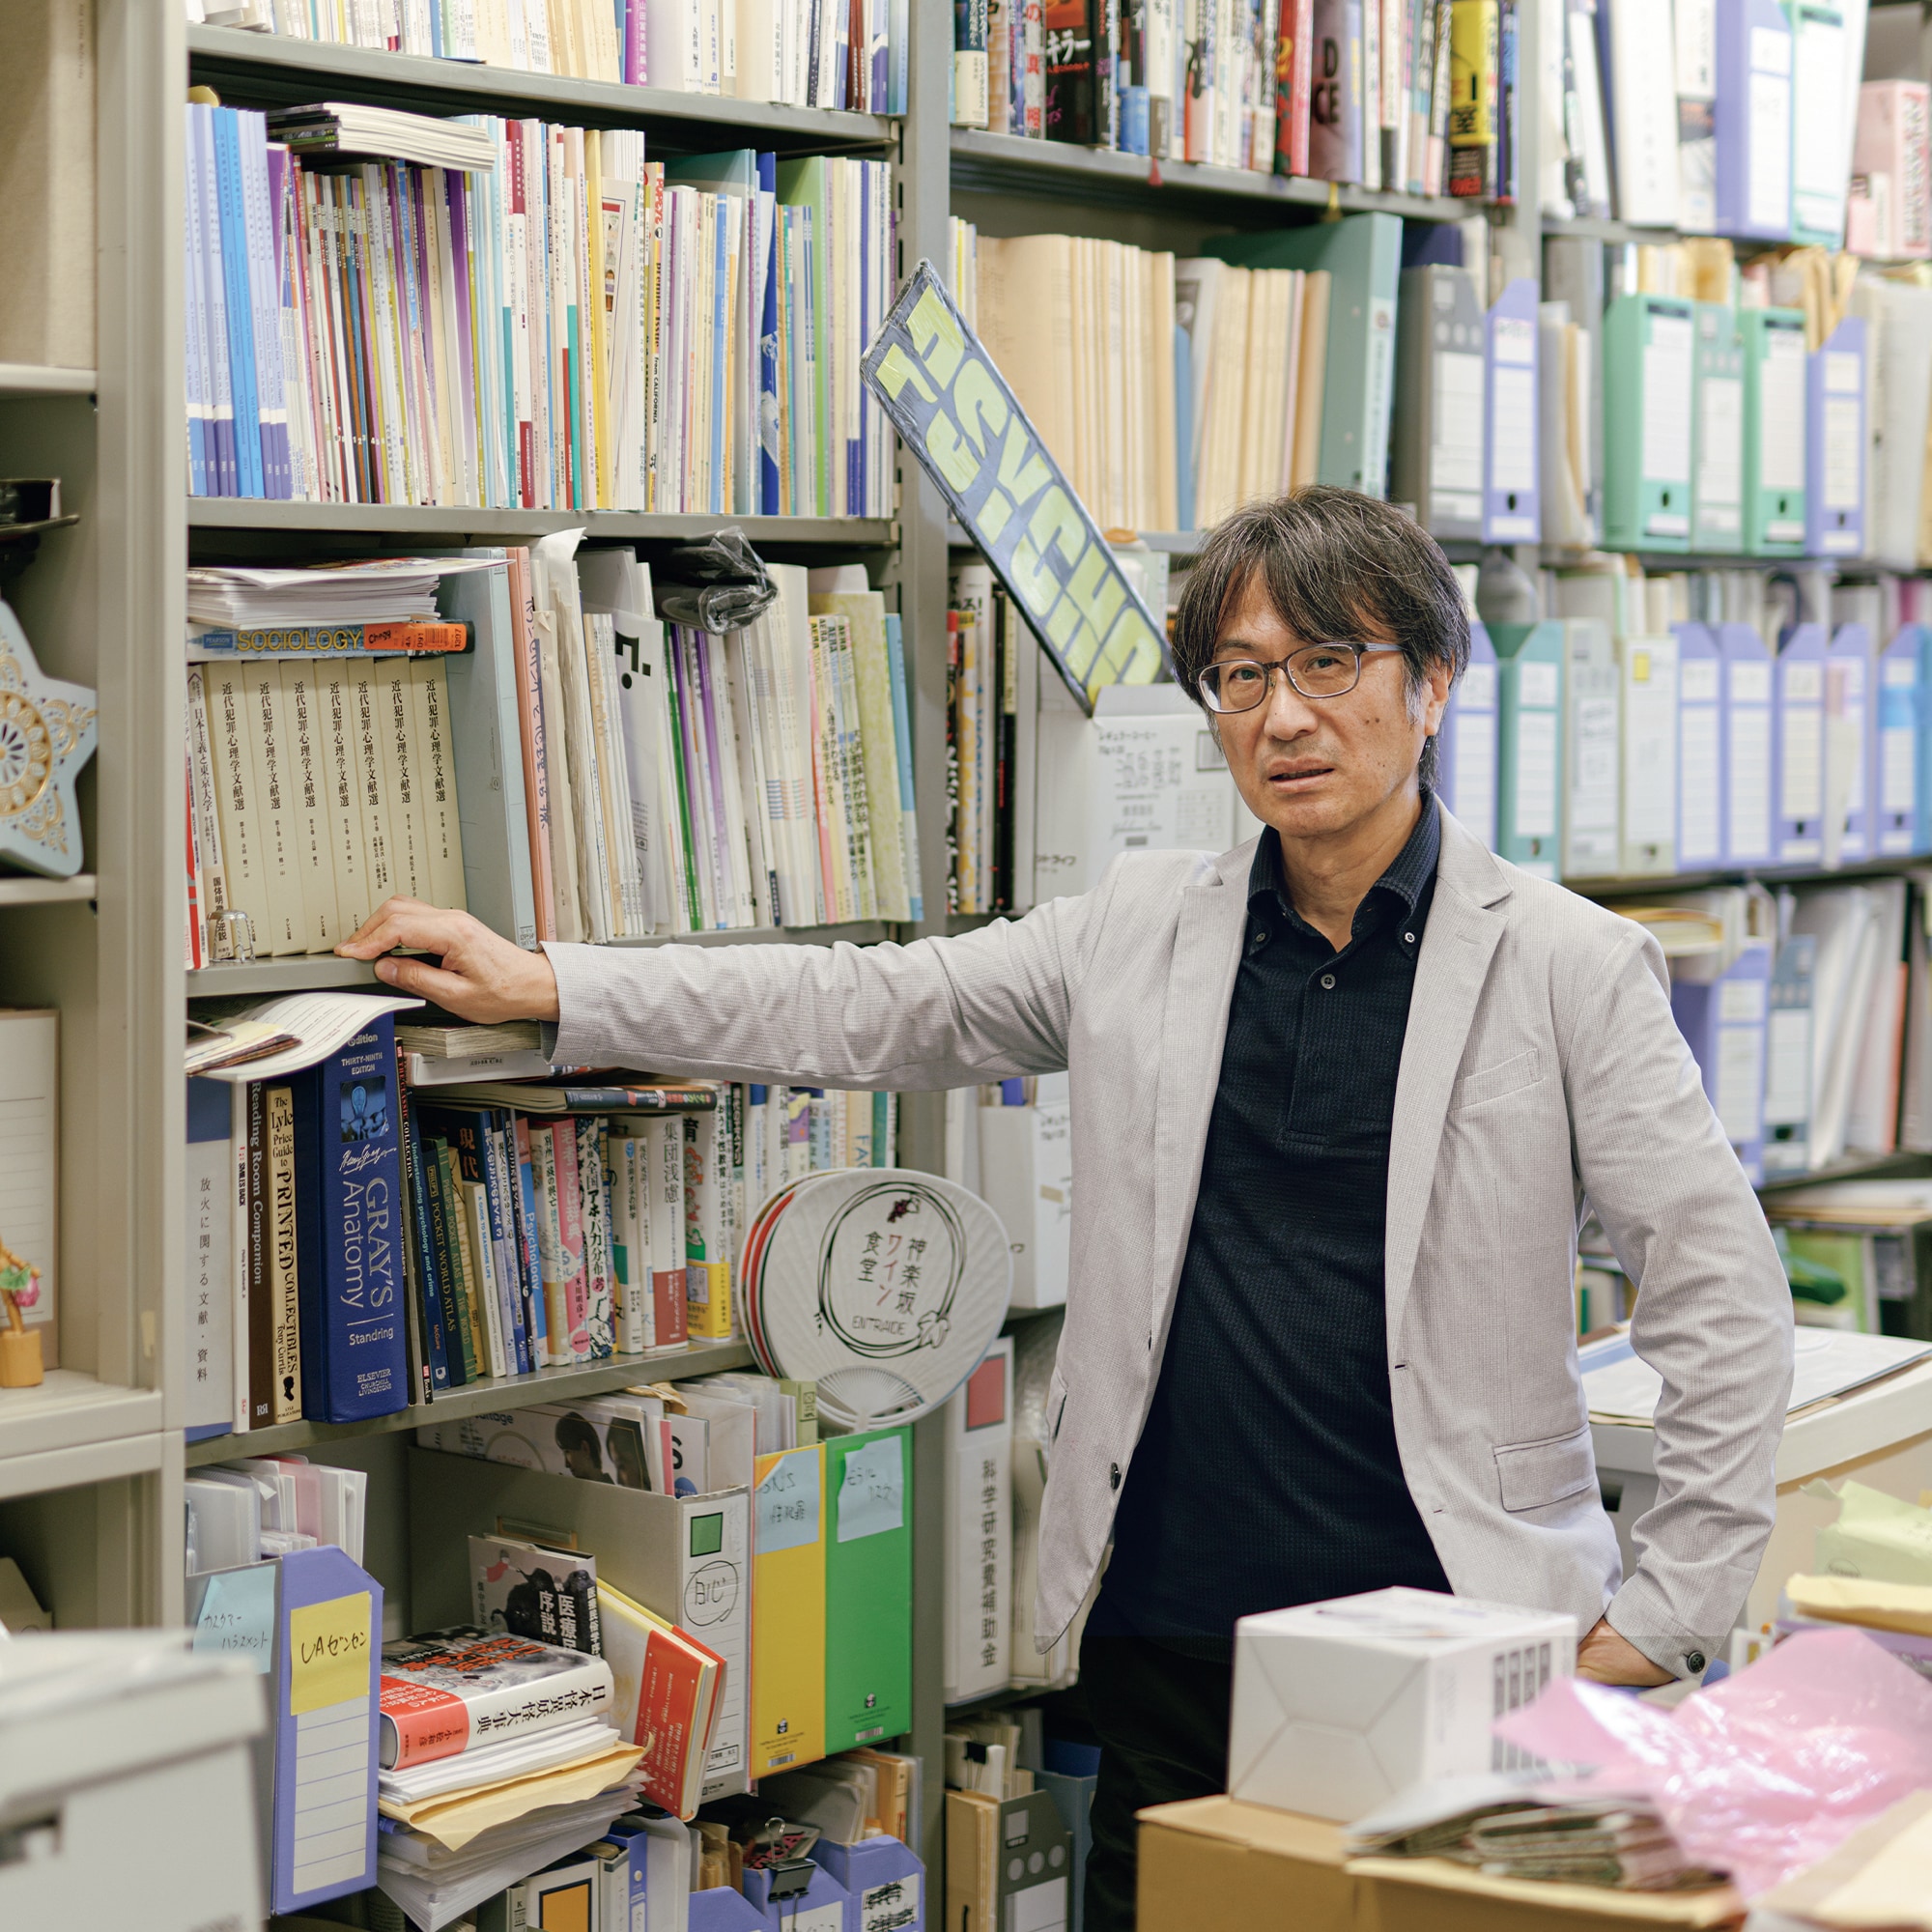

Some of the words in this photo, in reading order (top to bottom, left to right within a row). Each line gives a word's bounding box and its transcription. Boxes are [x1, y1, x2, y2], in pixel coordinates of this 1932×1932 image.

[1047, 29, 1092, 66] キラー
[655, 179, 664, 225] POPEYE
[206, 636, 230, 644] PEARSON
[238, 630, 363, 652] SOCIOLOGY
[368, 630, 391, 644] Chegg
[194, 707, 213, 812] 日本主義と東京大学
[222, 682, 245, 811] 近代犯罪心理学文献選
[259, 681, 281, 810] 近代犯罪心理学文献選
[294, 681, 316, 809] 近代犯罪心理学文献選
[329, 680, 350, 808] 近代犯罪心理学文献選
[357, 680, 379, 807] 近代犯罪心理学文献選
[391, 679, 412, 804] 近代犯罪心理学文献選
[426, 678, 446, 803] 近代犯罪心理学文献選
[341, 1051, 383, 1066] THIRTY-NINTH
[351, 1065, 375, 1075] EDITION
[249, 1081, 262, 1148] Reading
[271, 1110, 294, 1132] Lyle
[274, 1096, 288, 1107] The
[272, 1145, 294, 1158] Guide
[273, 1134, 293, 1146] Price
[404, 1122, 413, 1179] COLLECTION
[459, 1127, 480, 1179] 現代
[683, 1116, 699, 1143] 育
[251, 1151, 263, 1197] Room
[280, 1158, 288, 1167] to
[663, 1122, 679, 1204] 集団浅慮
[718, 1104, 727, 1228] おうち性教育はじめます
[276, 1171, 294, 1270] PRINTED
[411, 1142, 423, 1206] Understanding
[417, 1206, 430, 1254] psychology
[251, 1200, 264, 1285] Companion
[341, 1179, 364, 1309] Anatomy
[365, 1177, 394, 1308] GRAY'S
[433, 1203, 445, 1247] POCKET
[439, 1249, 451, 1300] WORLD
[526, 1211, 541, 1291] Psychology
[858, 1231, 884, 1284] 食堂
[876, 1234, 902, 1307] ワイン
[897, 1236, 927, 1316] 神楽坂
[197, 1177, 211, 1382] 放火に関する文献・資料
[522, 1285, 529, 1297] 6
[275, 1322, 285, 1344] Tony
[284, 1273, 298, 1373] COLLECTIBLES
[349, 1326, 394, 1346] Standring
[444, 1300, 457, 1332] ATLAS
[277, 1346, 286, 1376] Curtis
[356, 1368, 391, 1383] ELSEVIER
[360, 1378, 389, 1390] CHURCHILL
[474, 1412, 514, 1426] oltage
[980, 1459, 999, 1668] 科学研究費補助金
[203, 1611, 242, 1631] カスタマー
[539, 1590, 557, 1635] 序説
[299, 1633, 368, 1664] UAゼンセン
[476, 1685, 607, 1735] 日本怪異妖怪大事典
